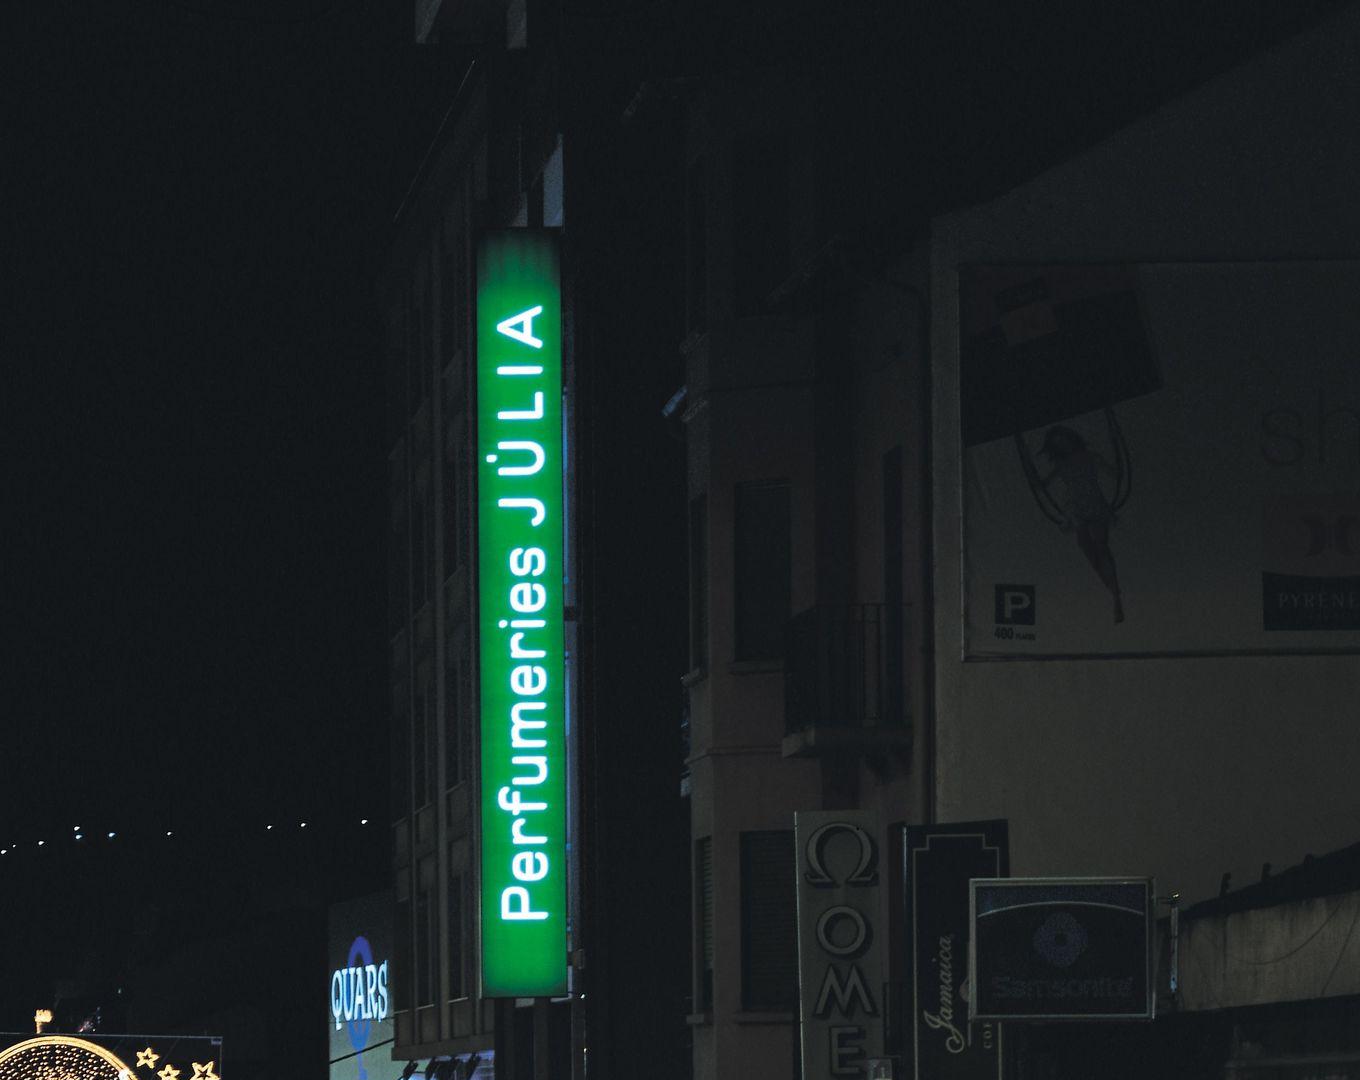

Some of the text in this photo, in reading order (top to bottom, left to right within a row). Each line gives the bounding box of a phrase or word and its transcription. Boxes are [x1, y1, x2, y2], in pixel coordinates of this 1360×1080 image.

[498, 546, 549, 922] Perfumeries
[331, 959, 388, 1030] QUARS
[923, 935, 966, 1054] Jamaica
